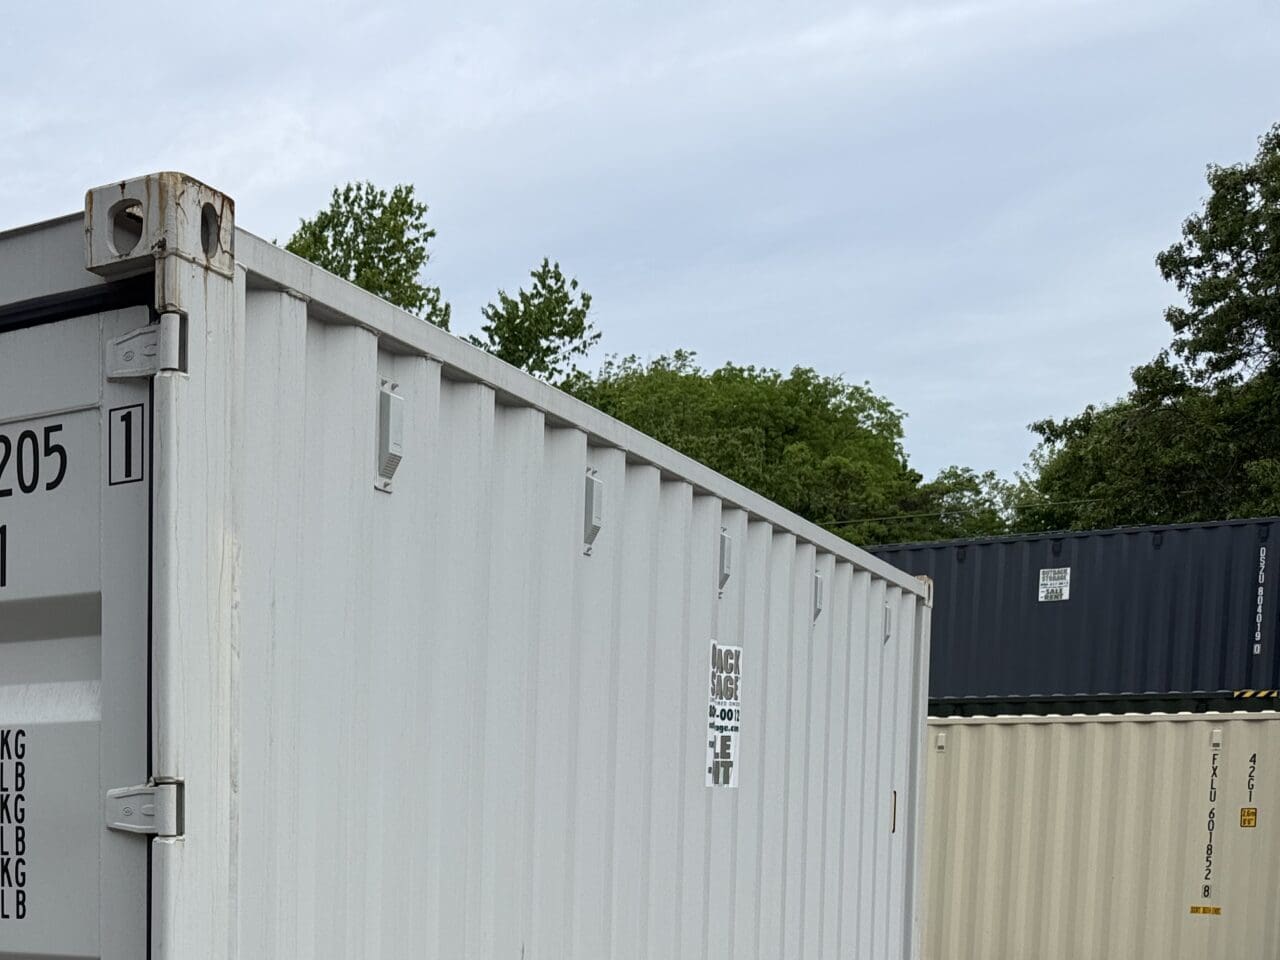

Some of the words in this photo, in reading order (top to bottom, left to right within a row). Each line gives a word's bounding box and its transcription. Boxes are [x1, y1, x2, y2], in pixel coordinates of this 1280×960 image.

[119, 410, 133, 479] 1
[1255, 586, 1264, 641] 804019
[0, 729, 26, 760] KG
[0, 761, 26, 792] LB
[1209, 753, 1219, 803] FXLU
[1247, 753, 1257, 803] 42G1
[0, 793, 26, 825] KG
[0, 825, 26, 856] LB
[1204, 808, 1216, 881] 601852
[0, 857, 26, 888] KG
[0, 888, 27, 920] LB
[1203, 885, 1210, 897] 8
